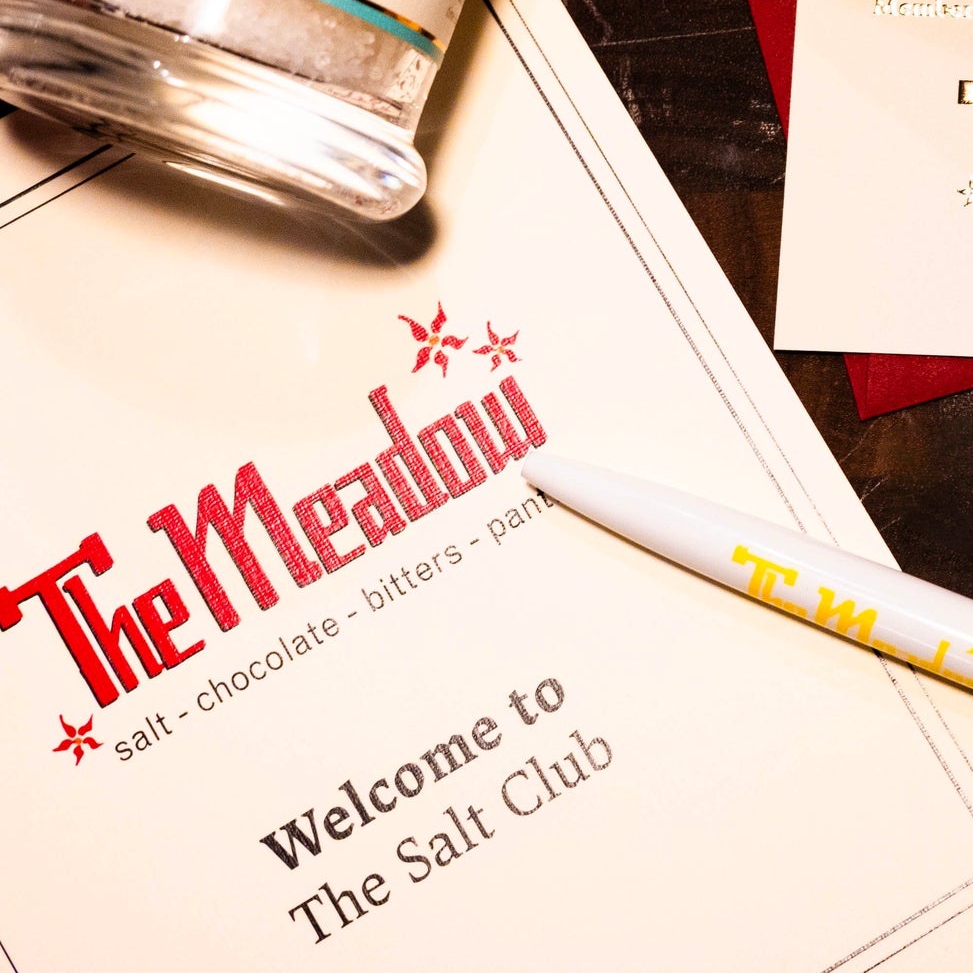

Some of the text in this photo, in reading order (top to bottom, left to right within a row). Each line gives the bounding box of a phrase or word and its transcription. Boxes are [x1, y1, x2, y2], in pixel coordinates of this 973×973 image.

[0, 375, 548, 708] The Meadow
[114, 488, 553, 762] salt chocolate bitters pant
[259, 675, 569, 873] Welcome to
[288, 728, 616, 947] The Salt Club
